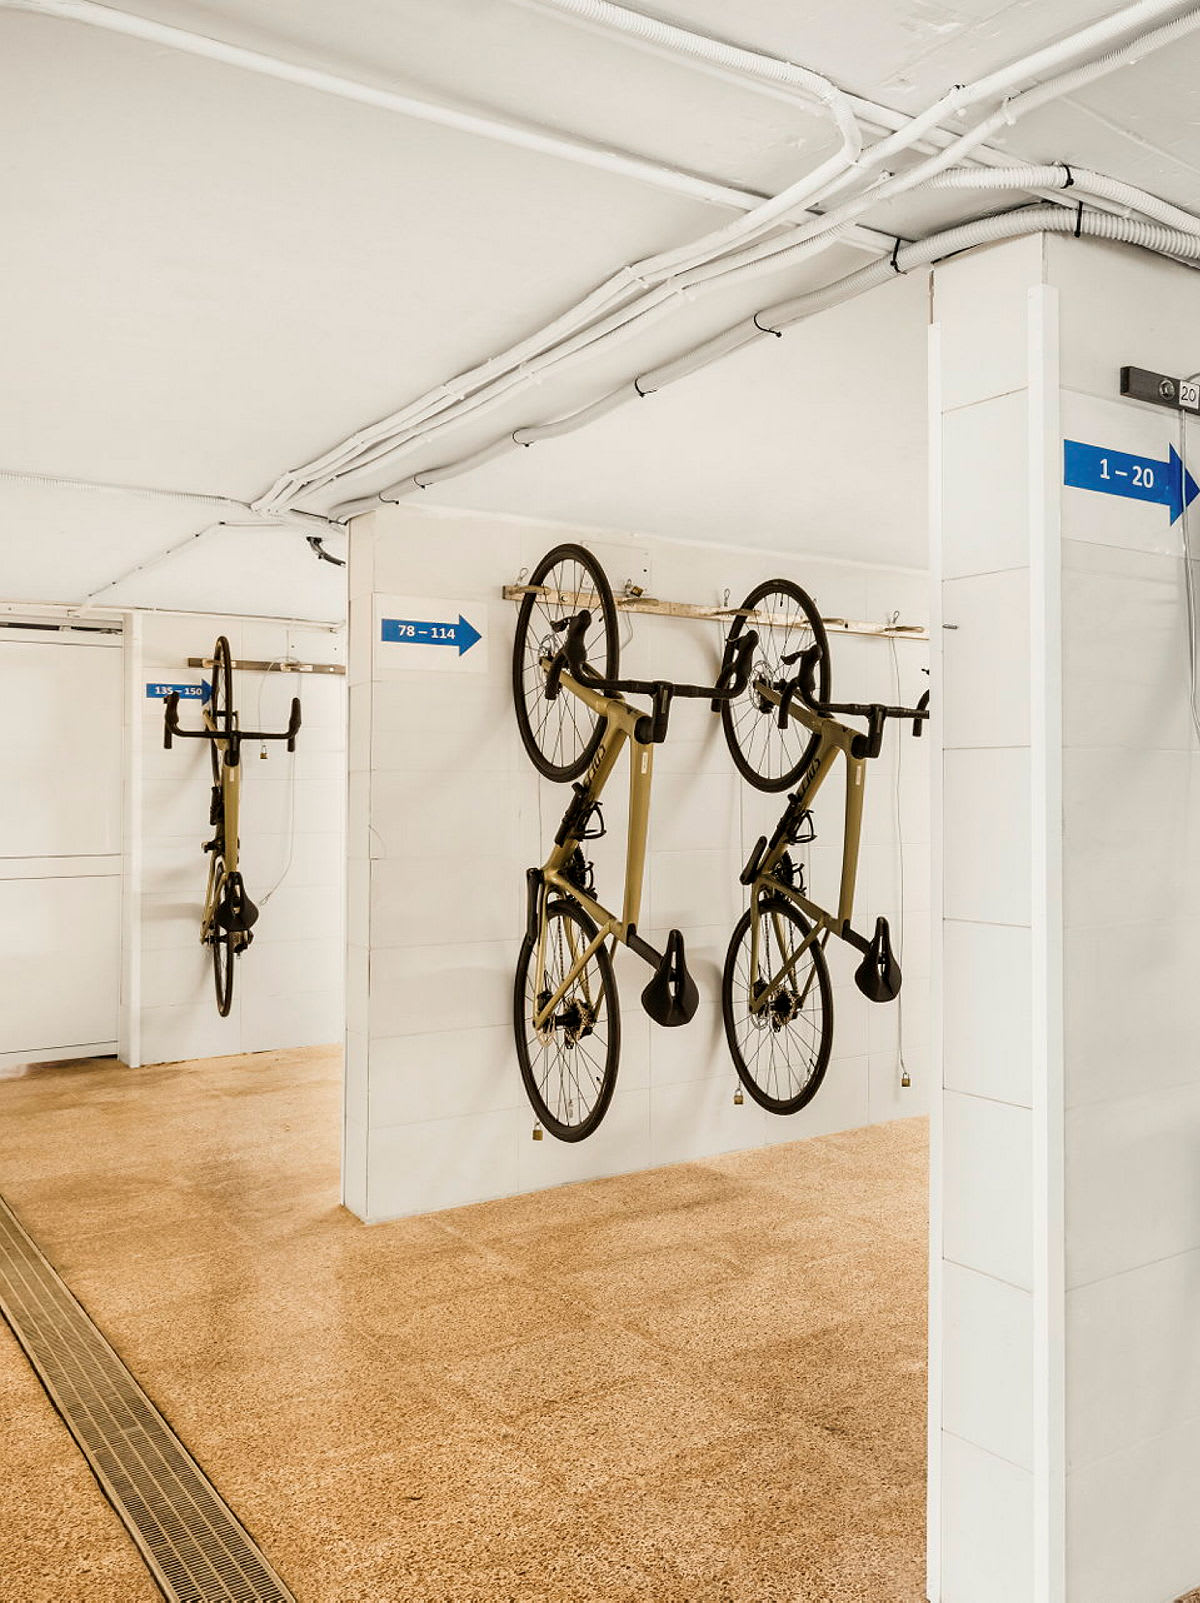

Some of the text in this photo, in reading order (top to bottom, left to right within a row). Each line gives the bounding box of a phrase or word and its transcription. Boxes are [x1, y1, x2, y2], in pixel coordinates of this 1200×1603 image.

[1180, 385, 1197, 403] 20
[1132, 465, 1154, 489] 20
[397, 624, 415, 637] 78
[430, 627, 456, 640] 114
